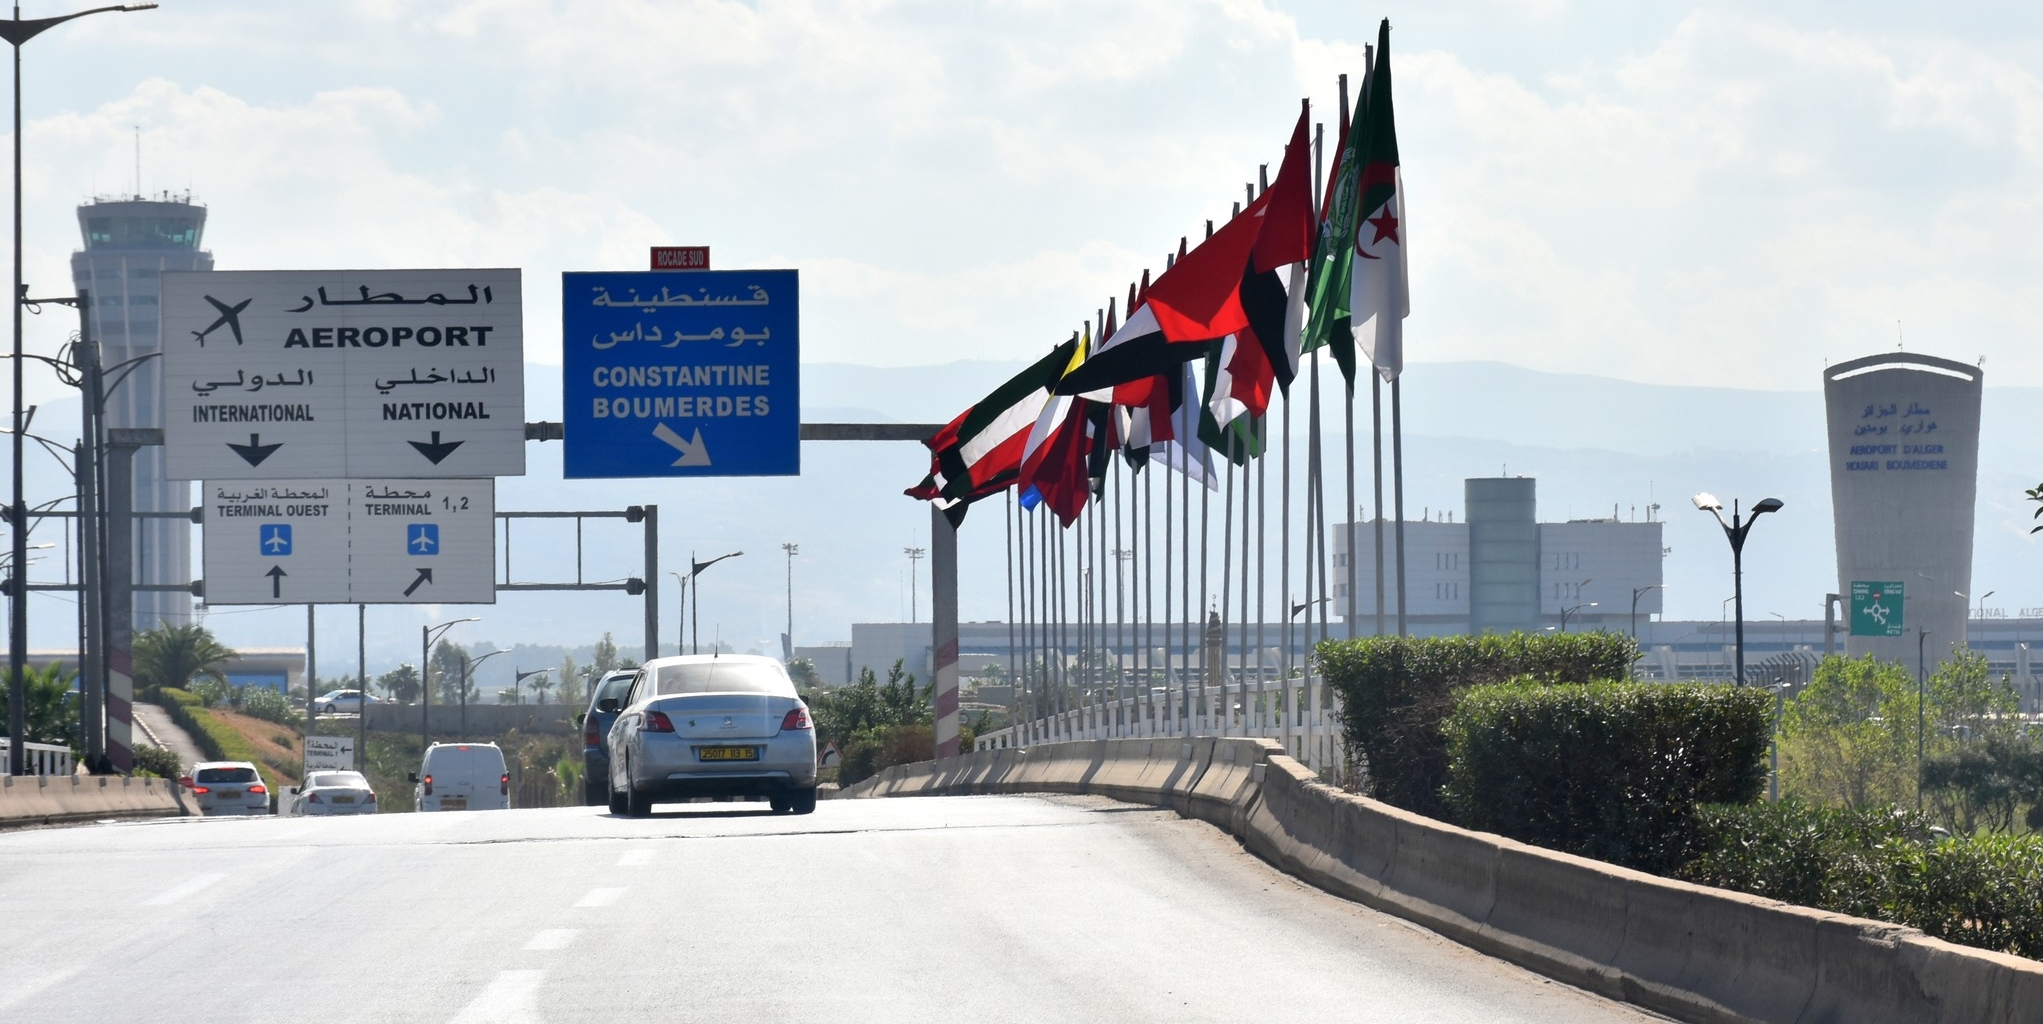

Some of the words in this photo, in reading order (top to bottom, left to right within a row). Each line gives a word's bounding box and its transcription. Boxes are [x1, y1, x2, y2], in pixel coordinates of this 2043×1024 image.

[657, 250, 688, 266] ROCADE
[688, 250, 704, 266] SUD
[284, 283, 493, 313] المطار
[592, 285, 770, 313] قسنطينة
[284, 326, 493, 349] AEROPORT
[592, 321, 770, 350] بومرداس
[192, 368, 314, 397] الدولي
[375, 366, 495, 395] الداخلي
[592, 365, 770, 388] CONSTANTINE
[192, 404, 314, 423] INTERNATIONAL
[382, 402, 490, 421] NATIONAL
[592, 396, 770, 418] BOUMERDES
[1902, 403, 1931, 418] مطار
[1850, 444, 1897, 455] AEROPORT
[1903, 444, 1944, 455] D'ALGER
[1846, 461, 1879, 471] HOUARI
[1886, 460, 1948, 470] BOUMEDIENE
[217, 487, 268, 503] الغربية
[271, 487, 329, 500] المحطة
[365, 485, 432, 499] محطة
[217, 505, 283, 517] TERMINAL
[286, 504, 329, 517] OUEST
[365, 503, 432, 516] TERMINAL
[702, 749, 725, 759] 25017
[730, 748, 740, 758] 113
[745, 748, 753, 758] 15
